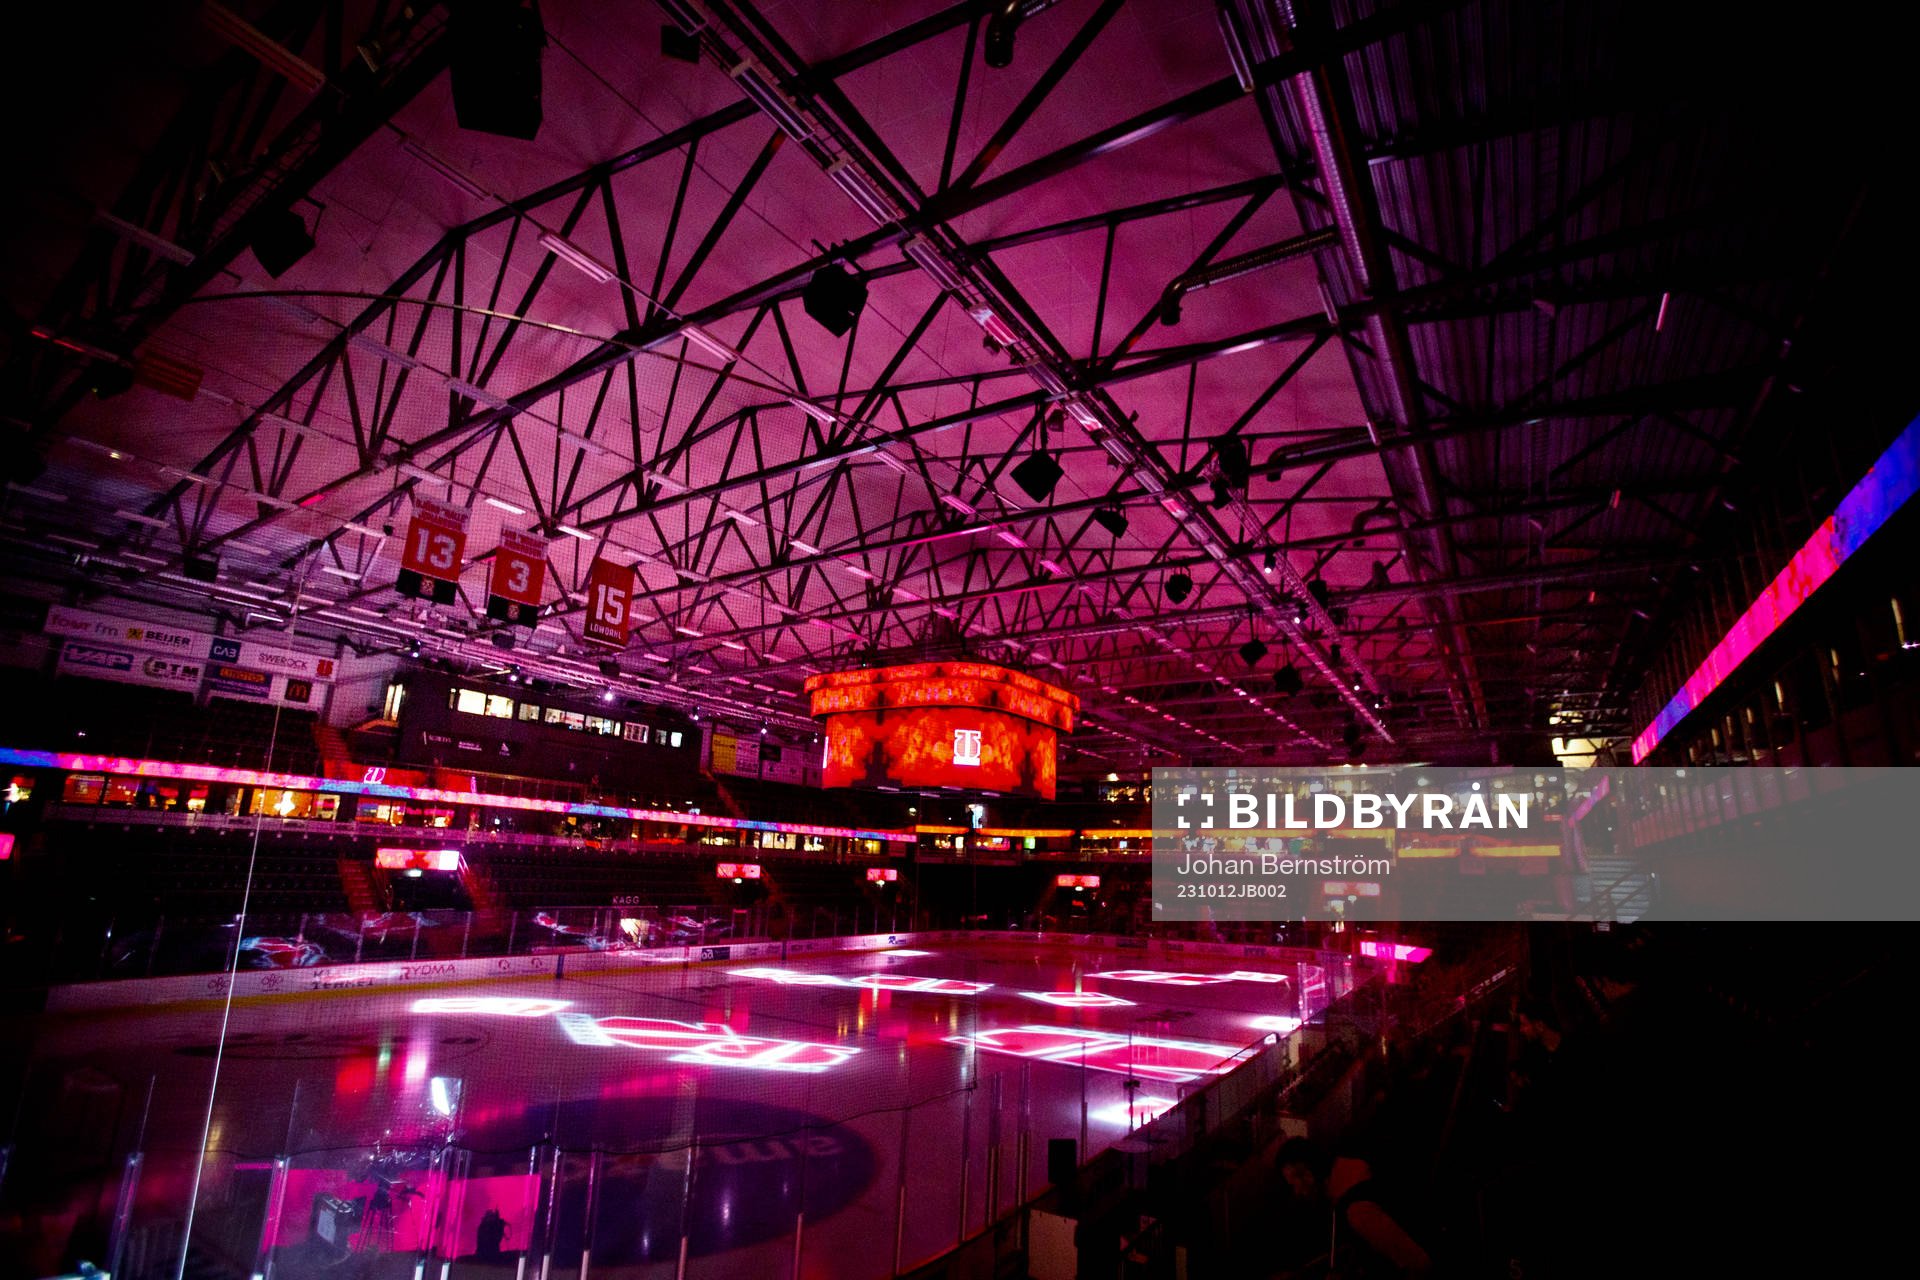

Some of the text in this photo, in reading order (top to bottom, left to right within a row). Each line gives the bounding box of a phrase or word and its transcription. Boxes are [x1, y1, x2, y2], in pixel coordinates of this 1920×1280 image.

[416, 528, 456, 570] 13
[508, 560, 530, 593] 3
[595, 584, 626, 625] 15
[145, 630, 191, 645] BEIJER
[259, 653, 308, 669] SWEROCK
[613, 896, 639, 904] KAGG
[400, 964, 456, 980] RYDMA
